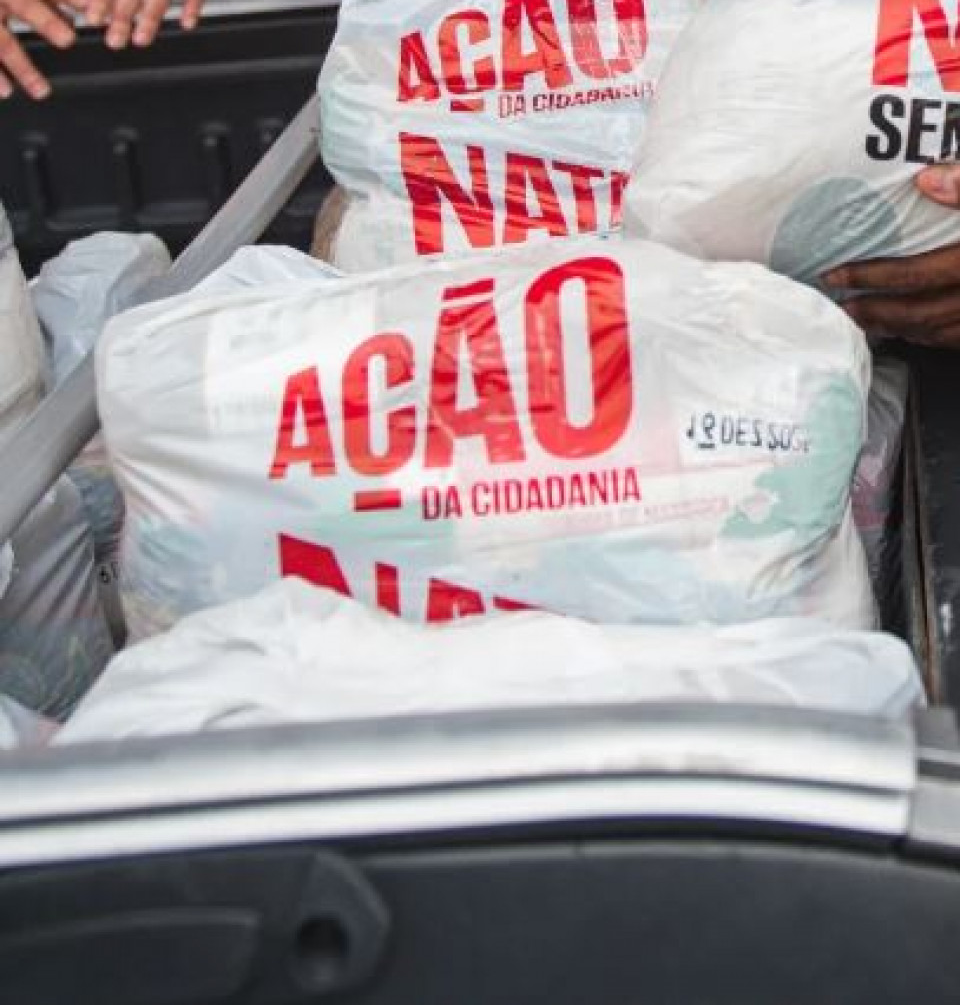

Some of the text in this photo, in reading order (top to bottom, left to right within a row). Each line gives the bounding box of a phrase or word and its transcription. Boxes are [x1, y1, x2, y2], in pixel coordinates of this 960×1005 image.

[499, 94, 526, 118] DA
[268, 256, 634, 512] AÇÃO
[421, 483, 462, 520] DA
[472, 467, 642, 516] CIDADANIA
